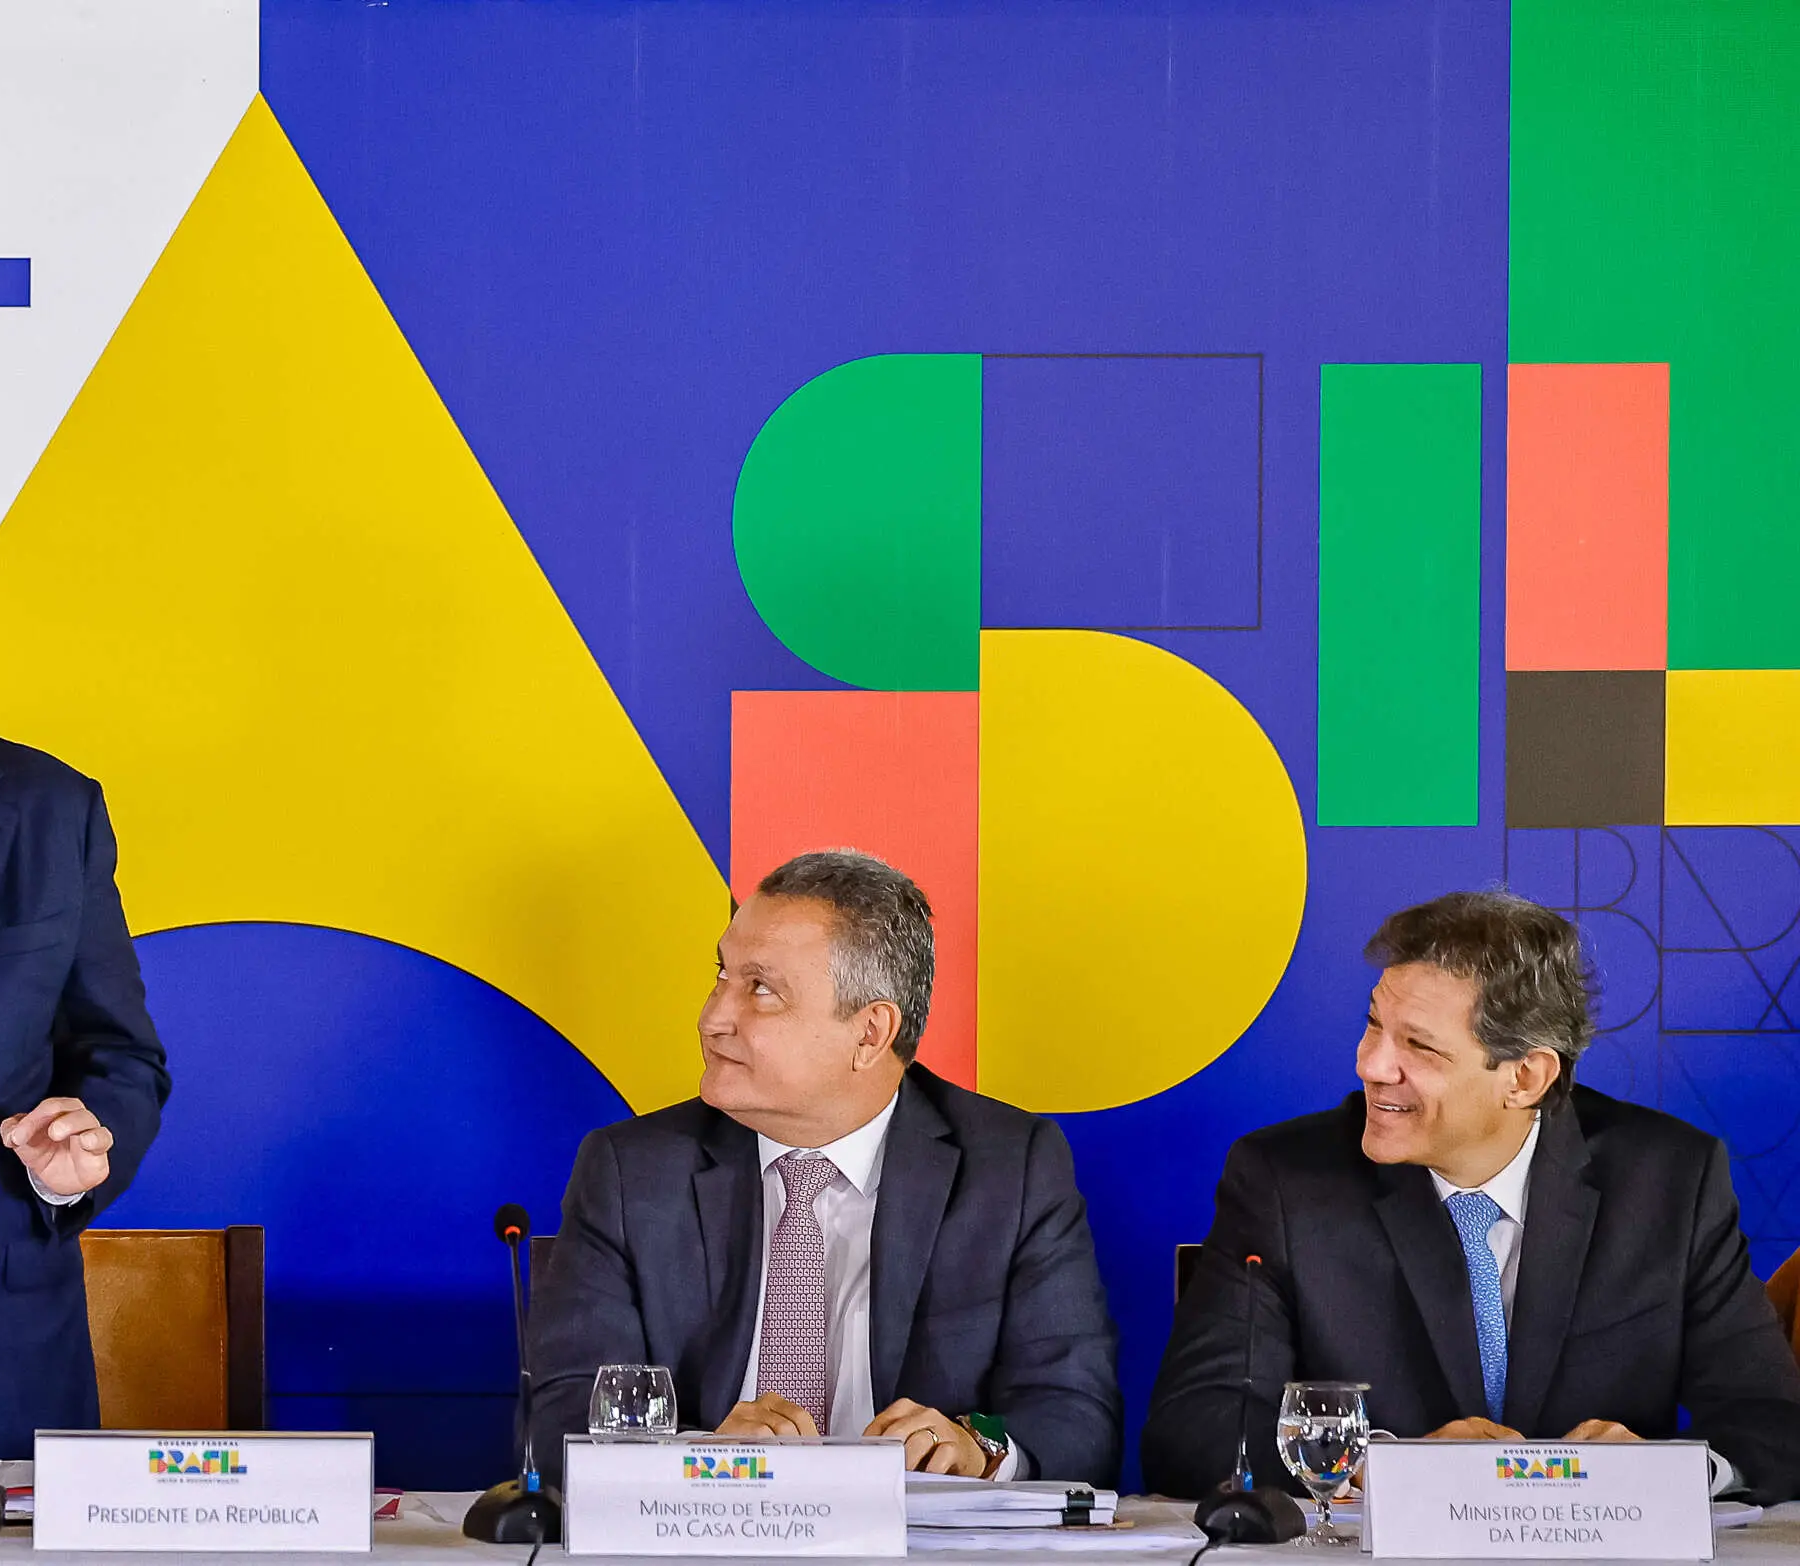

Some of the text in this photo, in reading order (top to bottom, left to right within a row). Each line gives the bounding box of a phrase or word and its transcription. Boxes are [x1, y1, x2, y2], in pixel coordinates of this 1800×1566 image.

[149, 1449, 247, 1474] BRASIL
[683, 1456, 774, 1479] BRASIL
[1496, 1457, 1588, 1479] BRASIL
[88, 1503, 319, 1524] PRESIDENTE DA REPÚBLICA
[640, 1500, 831, 1517] MINISTRO DE ESTADO
[1450, 1503, 1642, 1521] MINISTRO DE ESTADO
[656, 1519, 816, 1540] DA CASA CIVIL/PR
[1489, 1525, 1603, 1543] DA FAZENDA
